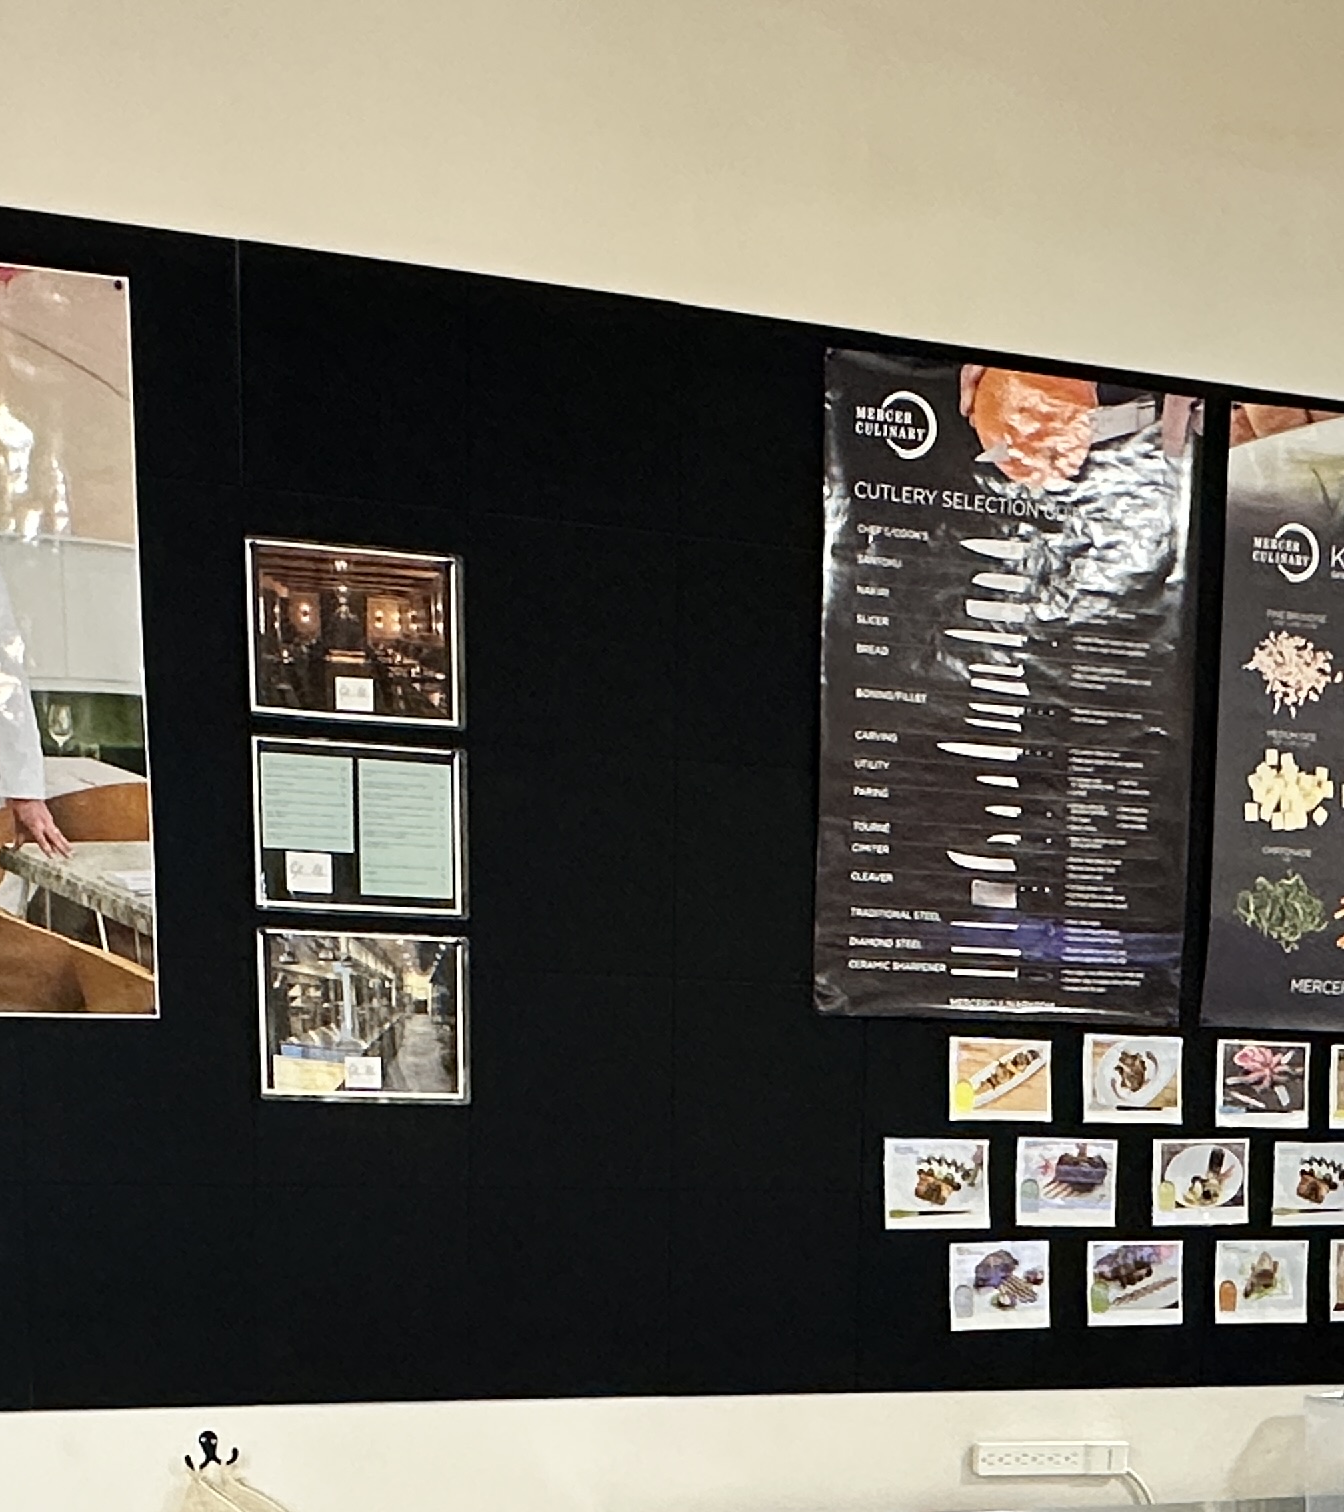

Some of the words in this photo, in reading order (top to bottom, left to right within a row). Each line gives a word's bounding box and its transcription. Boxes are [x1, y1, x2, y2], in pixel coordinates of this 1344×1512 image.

[855, 406, 912, 424] MERCER
[855, 420, 926, 441] CULINARY
[855, 481, 939, 506] CUTLERY
[942, 490, 1047, 519] SELECTION
[1253, 537, 1300, 552] MERCER
[1253, 551, 1310, 567] CULINARY
[856, 613, 890, 626] SLICER
[855, 730, 898, 743] CARVING
[854, 759, 890, 771] UTILITY
[853, 786, 890, 798] PARING
[850, 871, 894, 883] CLEAVER
